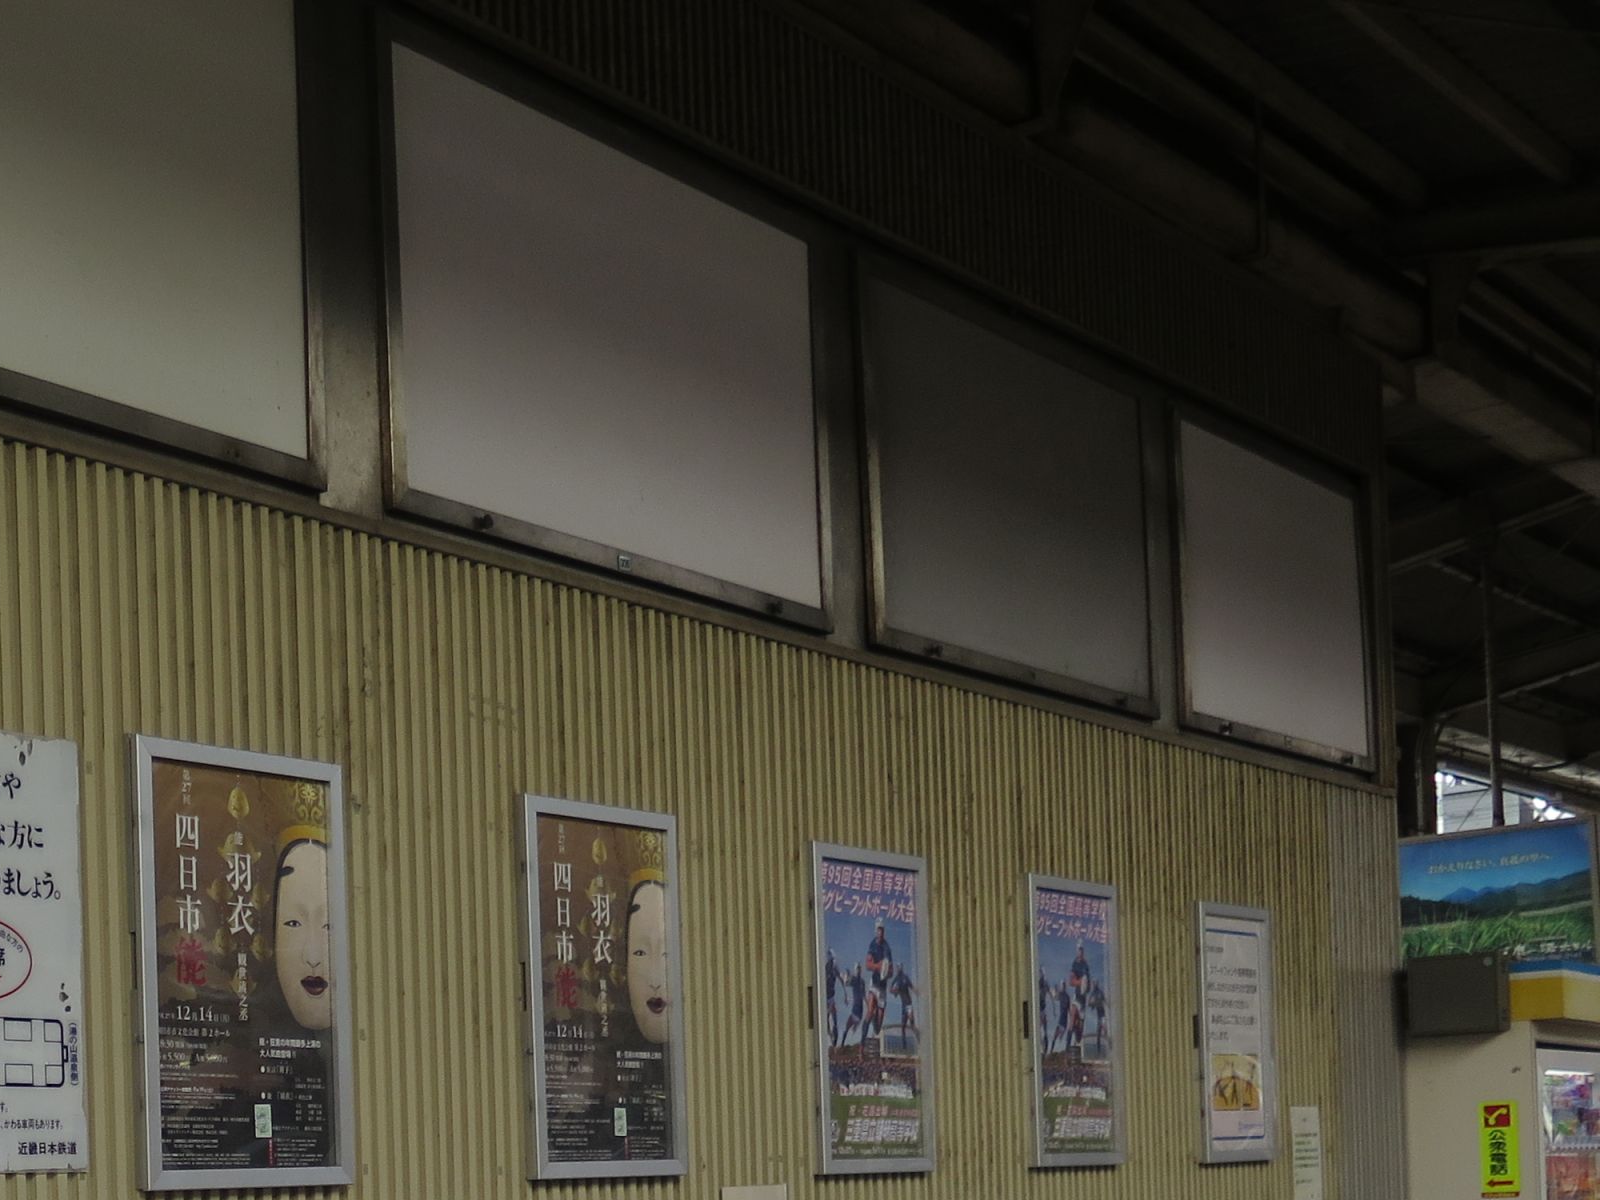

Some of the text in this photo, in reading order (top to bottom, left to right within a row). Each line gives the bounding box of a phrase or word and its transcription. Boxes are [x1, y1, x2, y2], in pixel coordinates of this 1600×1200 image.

[226, 852, 256, 936] 羽衣
[822, 888, 915, 923] グビーフットボール大会
[18, 1141, 78, 1156] 近畿日本鉄道
[1488, 1128, 1509, 1177] 公衆電話
